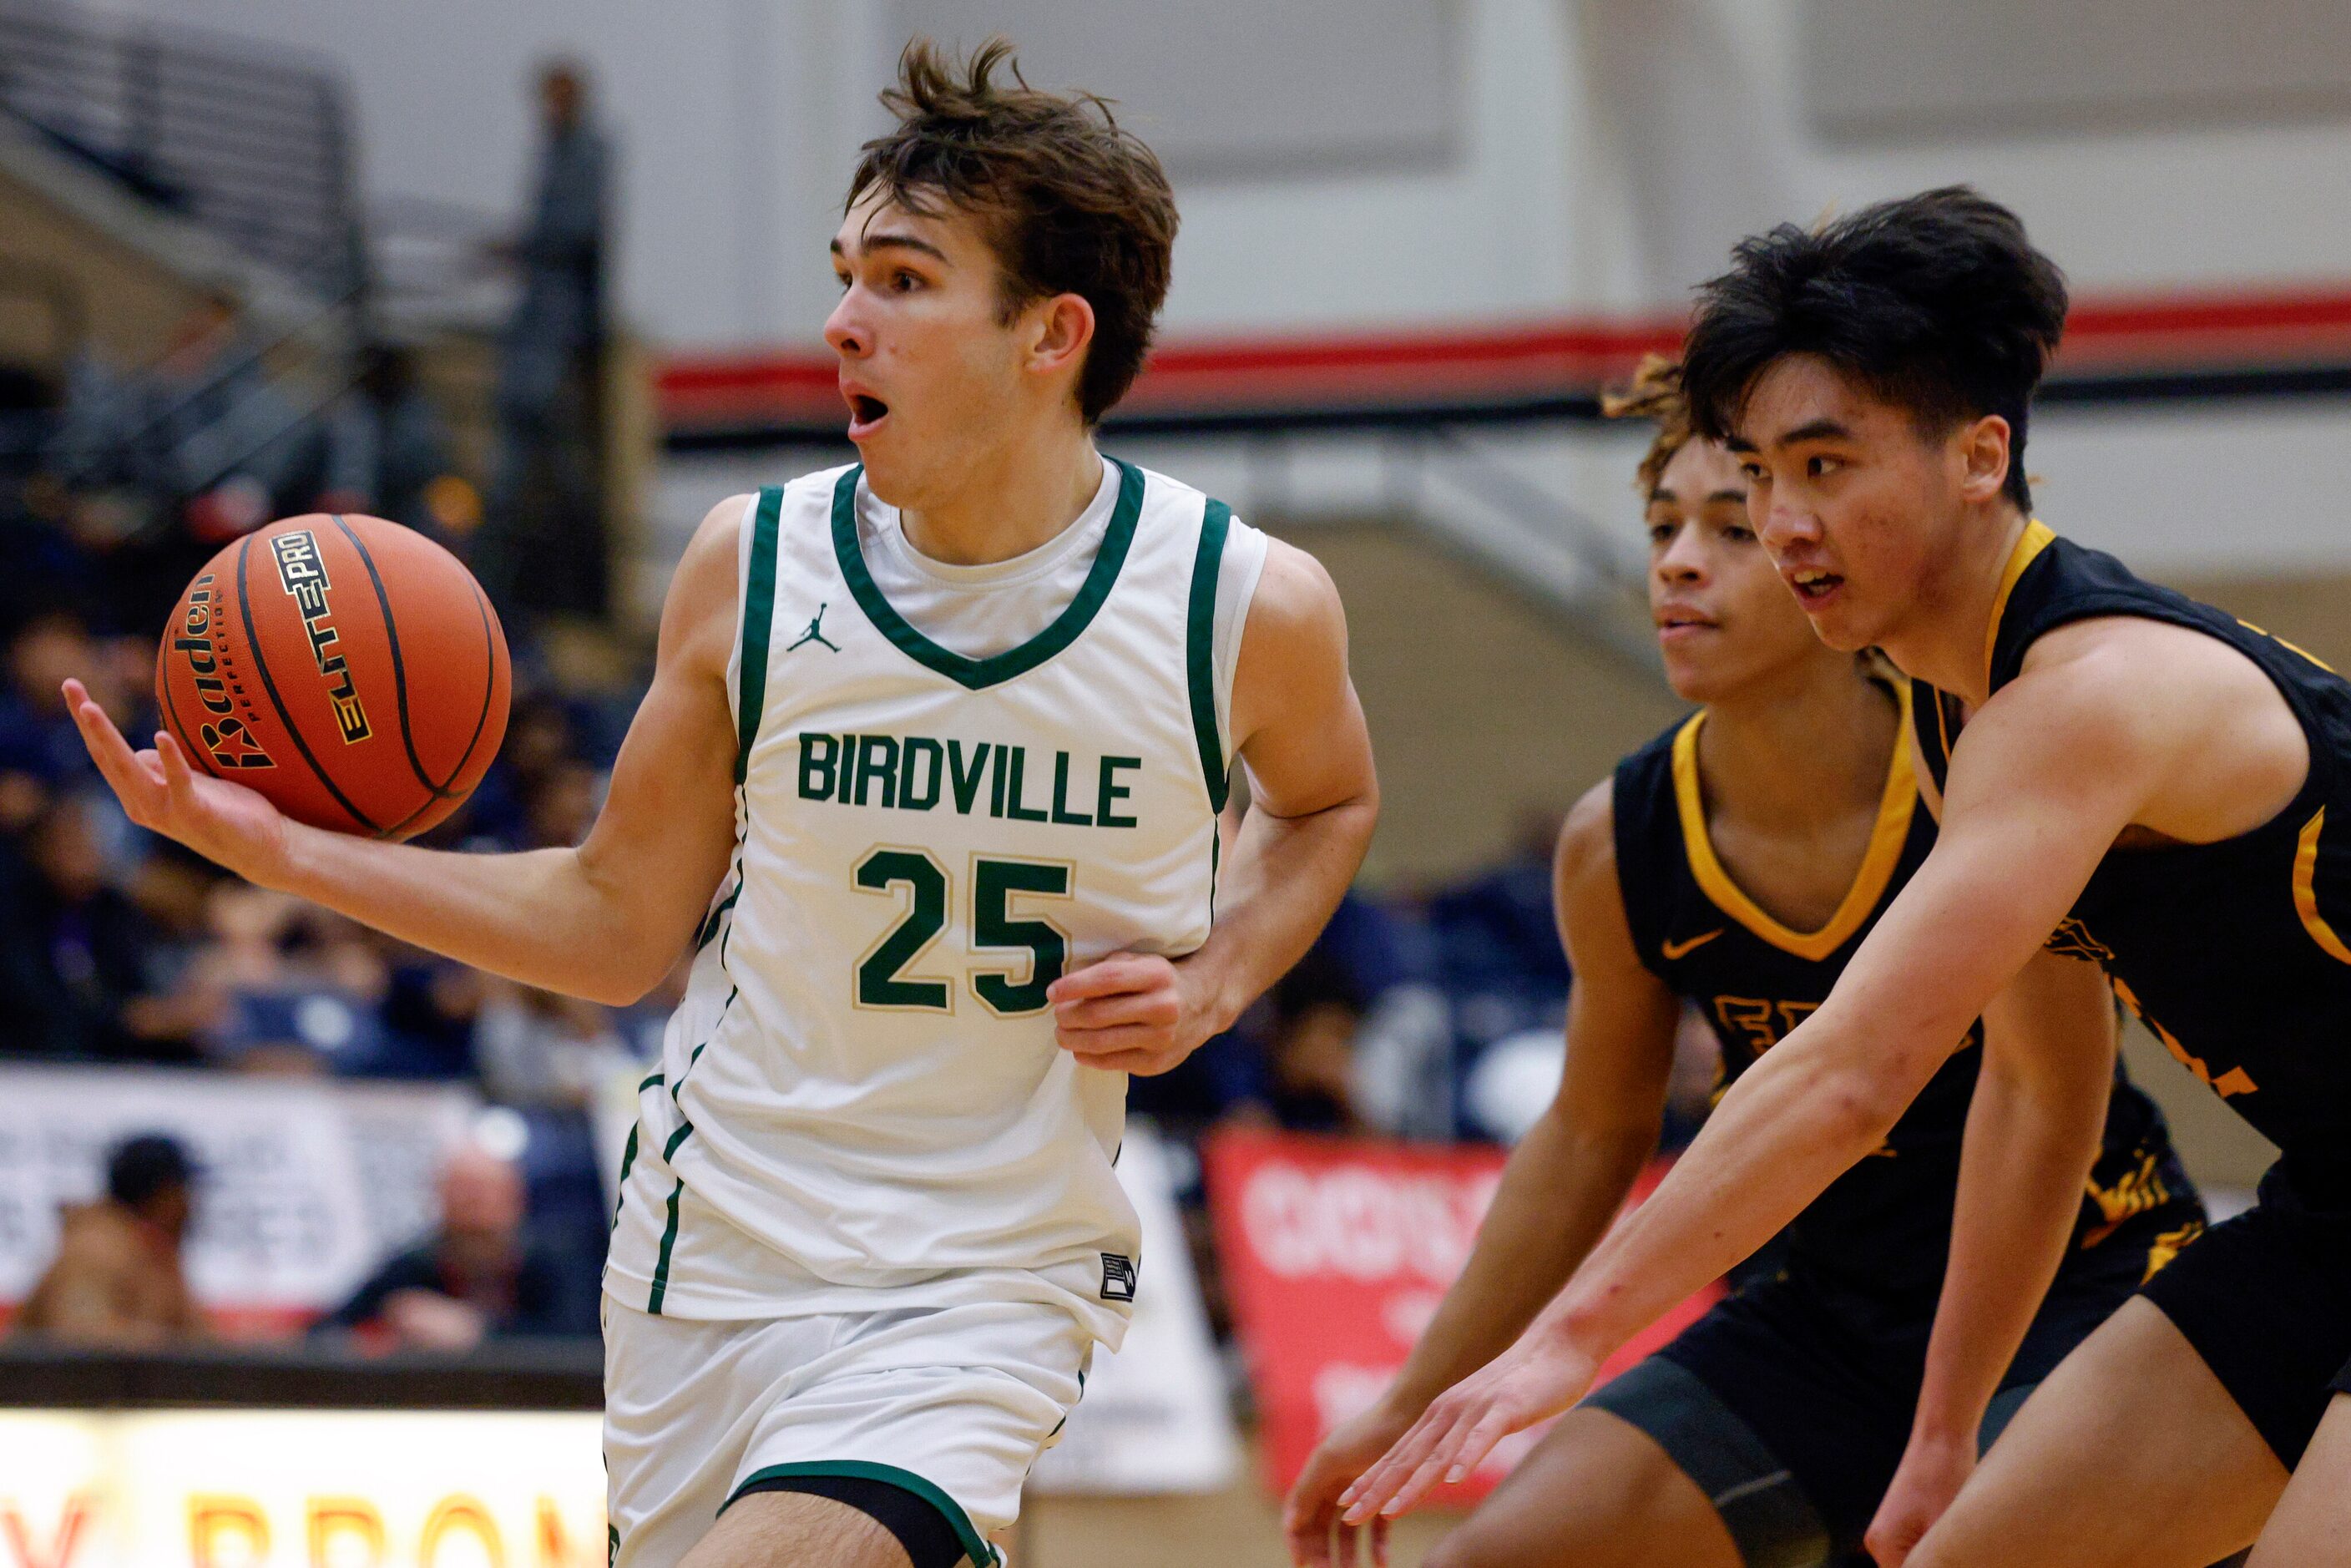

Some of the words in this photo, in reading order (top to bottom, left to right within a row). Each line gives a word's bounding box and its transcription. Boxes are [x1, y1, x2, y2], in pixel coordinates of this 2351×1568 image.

[276, 532, 320, 580] PRO
[174, 574, 277, 768] Baden
[293, 579, 372, 745] ELITE
[798, 732, 1142, 828] BIRDVILLE
[850, 842, 1077, 1020] 25
